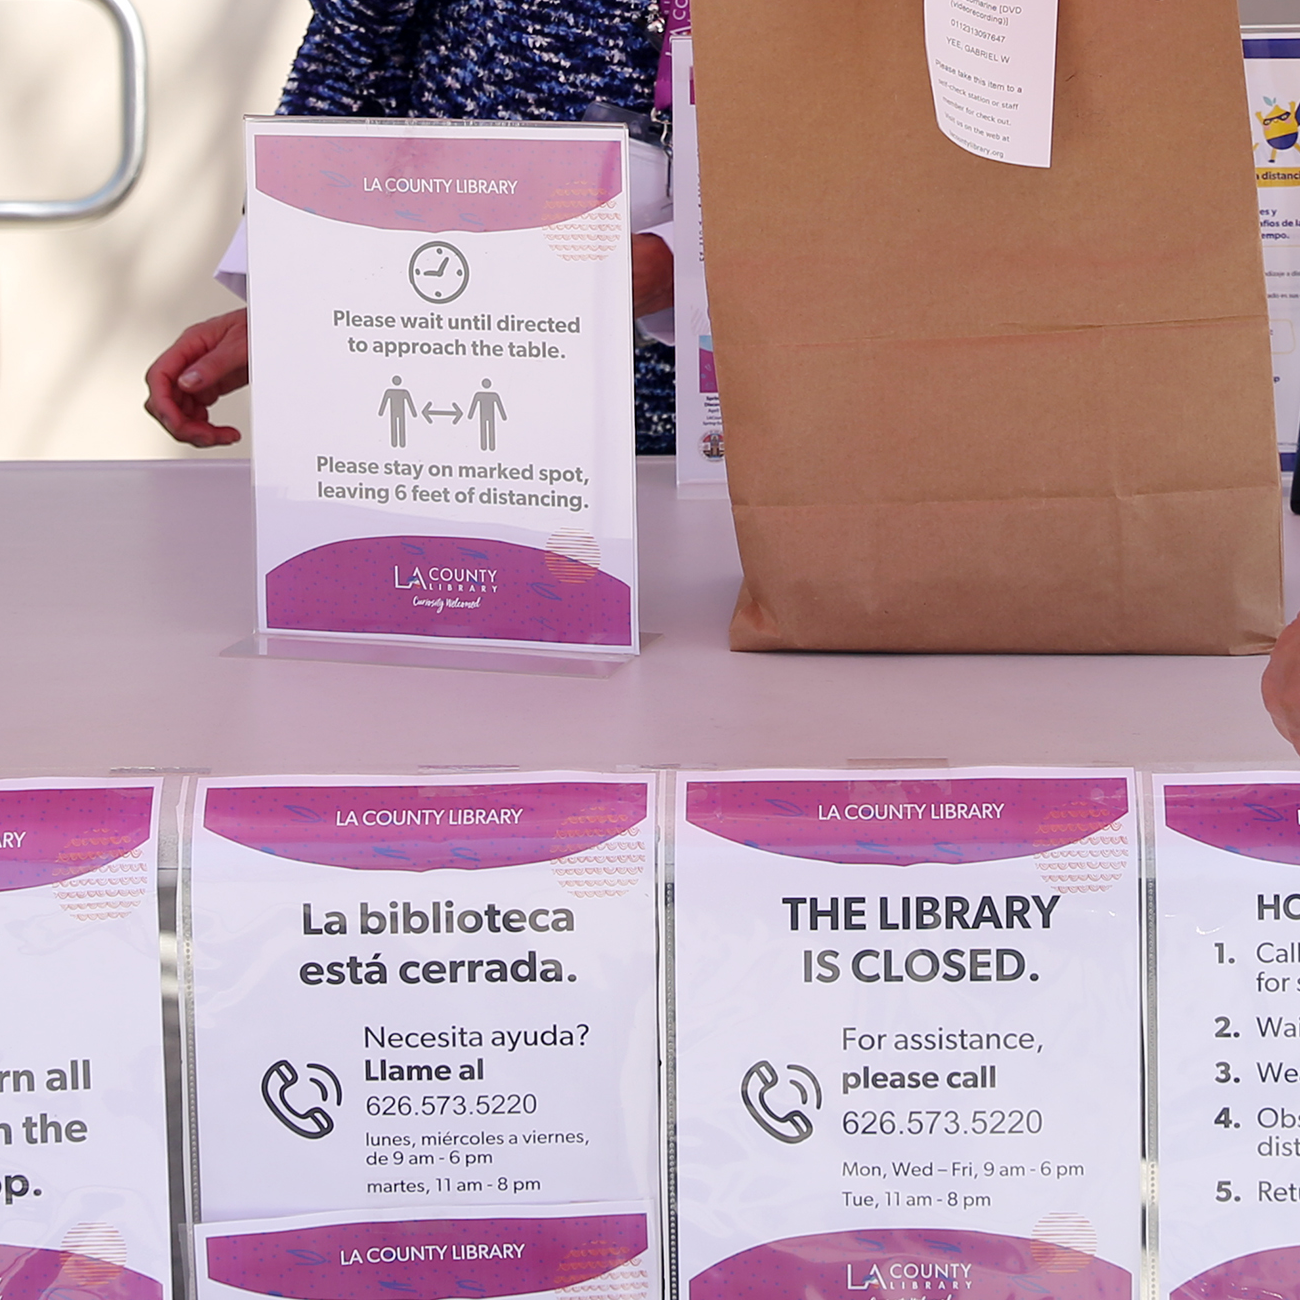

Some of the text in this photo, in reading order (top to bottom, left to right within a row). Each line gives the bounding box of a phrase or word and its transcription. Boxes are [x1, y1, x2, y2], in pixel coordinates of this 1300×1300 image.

[958, 69, 972, 81] take
[974, 76, 986, 86] this
[988, 81, 1004, 91] item
[1007, 84, 1014, 92] to
[363, 177, 518, 195] LA COUNTY LIBRARY
[333, 309, 581, 334] Please wait until directed
[347, 336, 566, 359] to approach the table.
[316, 455, 589, 486] Please stay on marked spot,
[317, 481, 589, 513] leaving 6 feet of distancing.
[302, 899, 575, 936] La biblioteca
[781, 894, 1061, 931] THE LIBRARY
[1214, 942, 1236, 964] 1.
[299, 950, 577, 986] está cerrada.
[803, 948, 1040, 984] IS CLOSED.
[1255, 971, 1291, 993] for
[364, 1023, 590, 1052] Necesita ayuda?
[843, 1026, 1043, 1054] For assistance,
[1214, 1016, 1241, 1039] 2.
[45, 1059, 91, 1092] all
[364, 1057, 484, 1082] Llame al
[842, 1065, 996, 1095] please call
[1214, 1061, 1241, 1084] 3.
[366, 1093, 537, 1116] 626.573.5220
[21, 1112, 88, 1145] the
[1213, 1106, 1241, 1129] 4.
[365, 1130, 589, 1149] lunes, miércoles a viernes,
[842, 1160, 1084, 1180] Mon, Wed Fri, 9 am 6 pm
[1215, 1180, 1241, 1203] 5.
